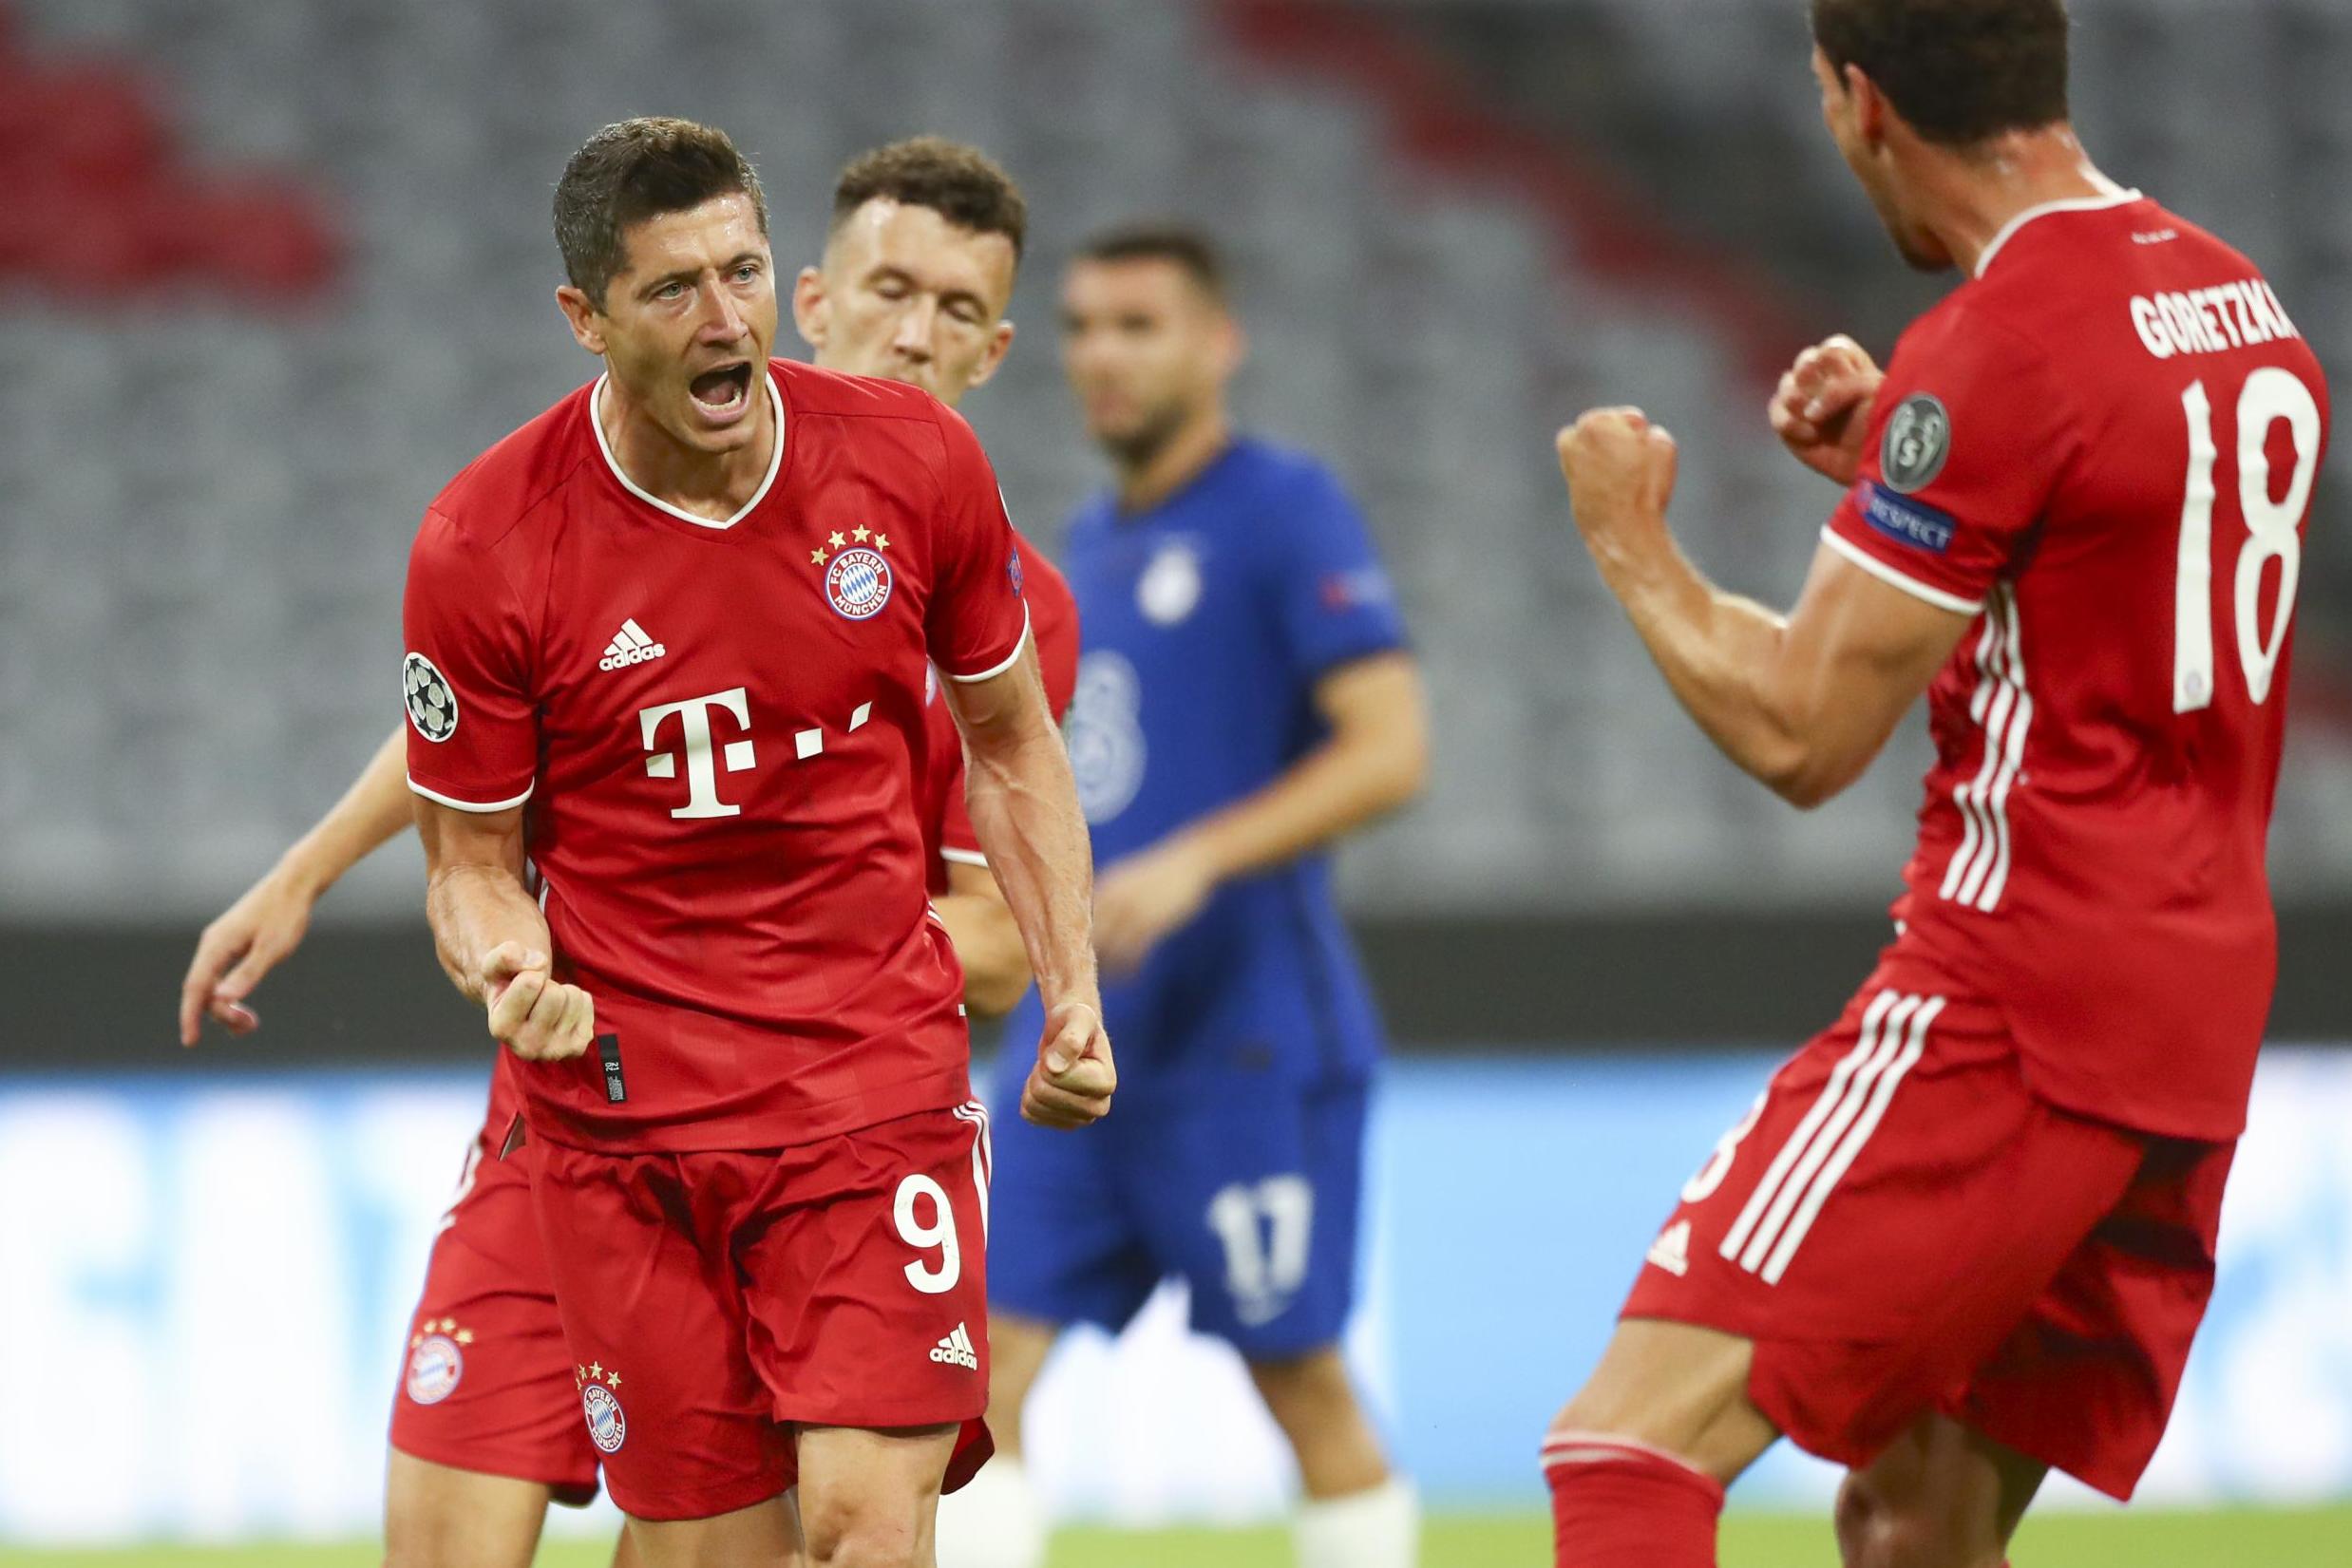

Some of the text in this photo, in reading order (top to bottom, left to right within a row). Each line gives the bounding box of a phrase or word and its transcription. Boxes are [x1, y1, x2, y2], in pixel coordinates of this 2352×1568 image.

[1870, 496, 1952, 549] RESPECT
[2172, 367, 2321, 714] 18
[830, 553, 884, 585] FC BAYERN
[598, 643, 666, 671] adidas
[638, 687, 756, 819] T
[893, 1173, 960, 1294] 9
[929, 1347, 977, 1370] adidas
